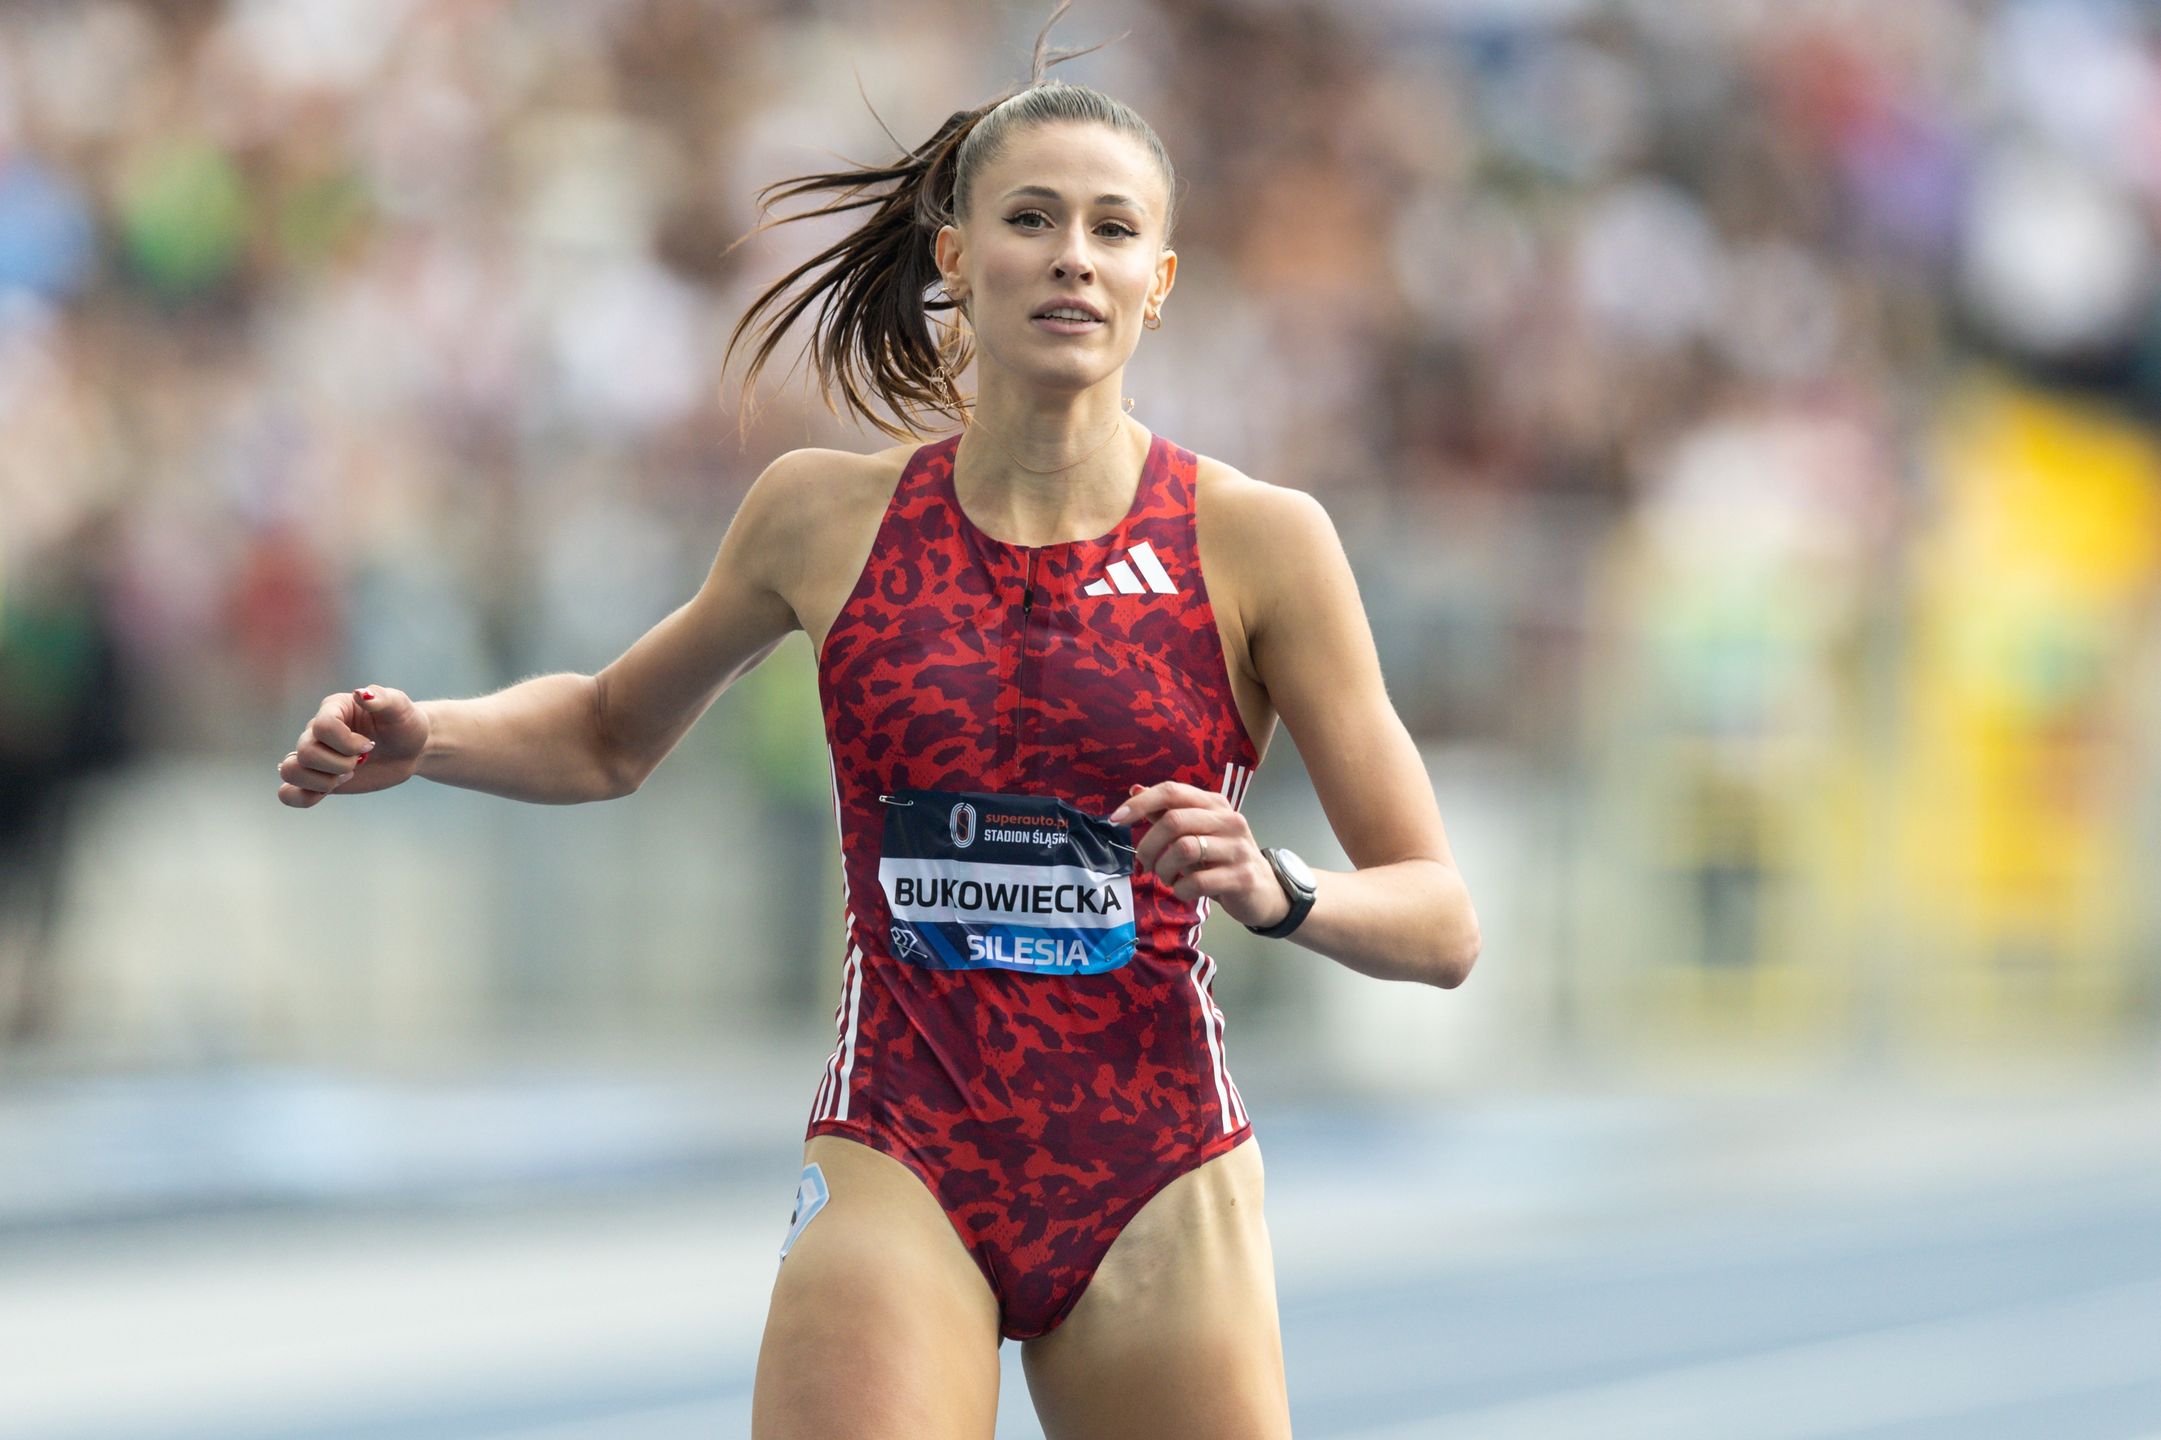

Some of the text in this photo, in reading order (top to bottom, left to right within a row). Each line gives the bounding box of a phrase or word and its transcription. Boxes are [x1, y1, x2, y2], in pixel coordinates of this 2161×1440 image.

[984, 829, 1030, 844] STADION
[894, 877, 1122, 915] BUKOWIECKA
[966, 934, 1090, 967] SILESIA
